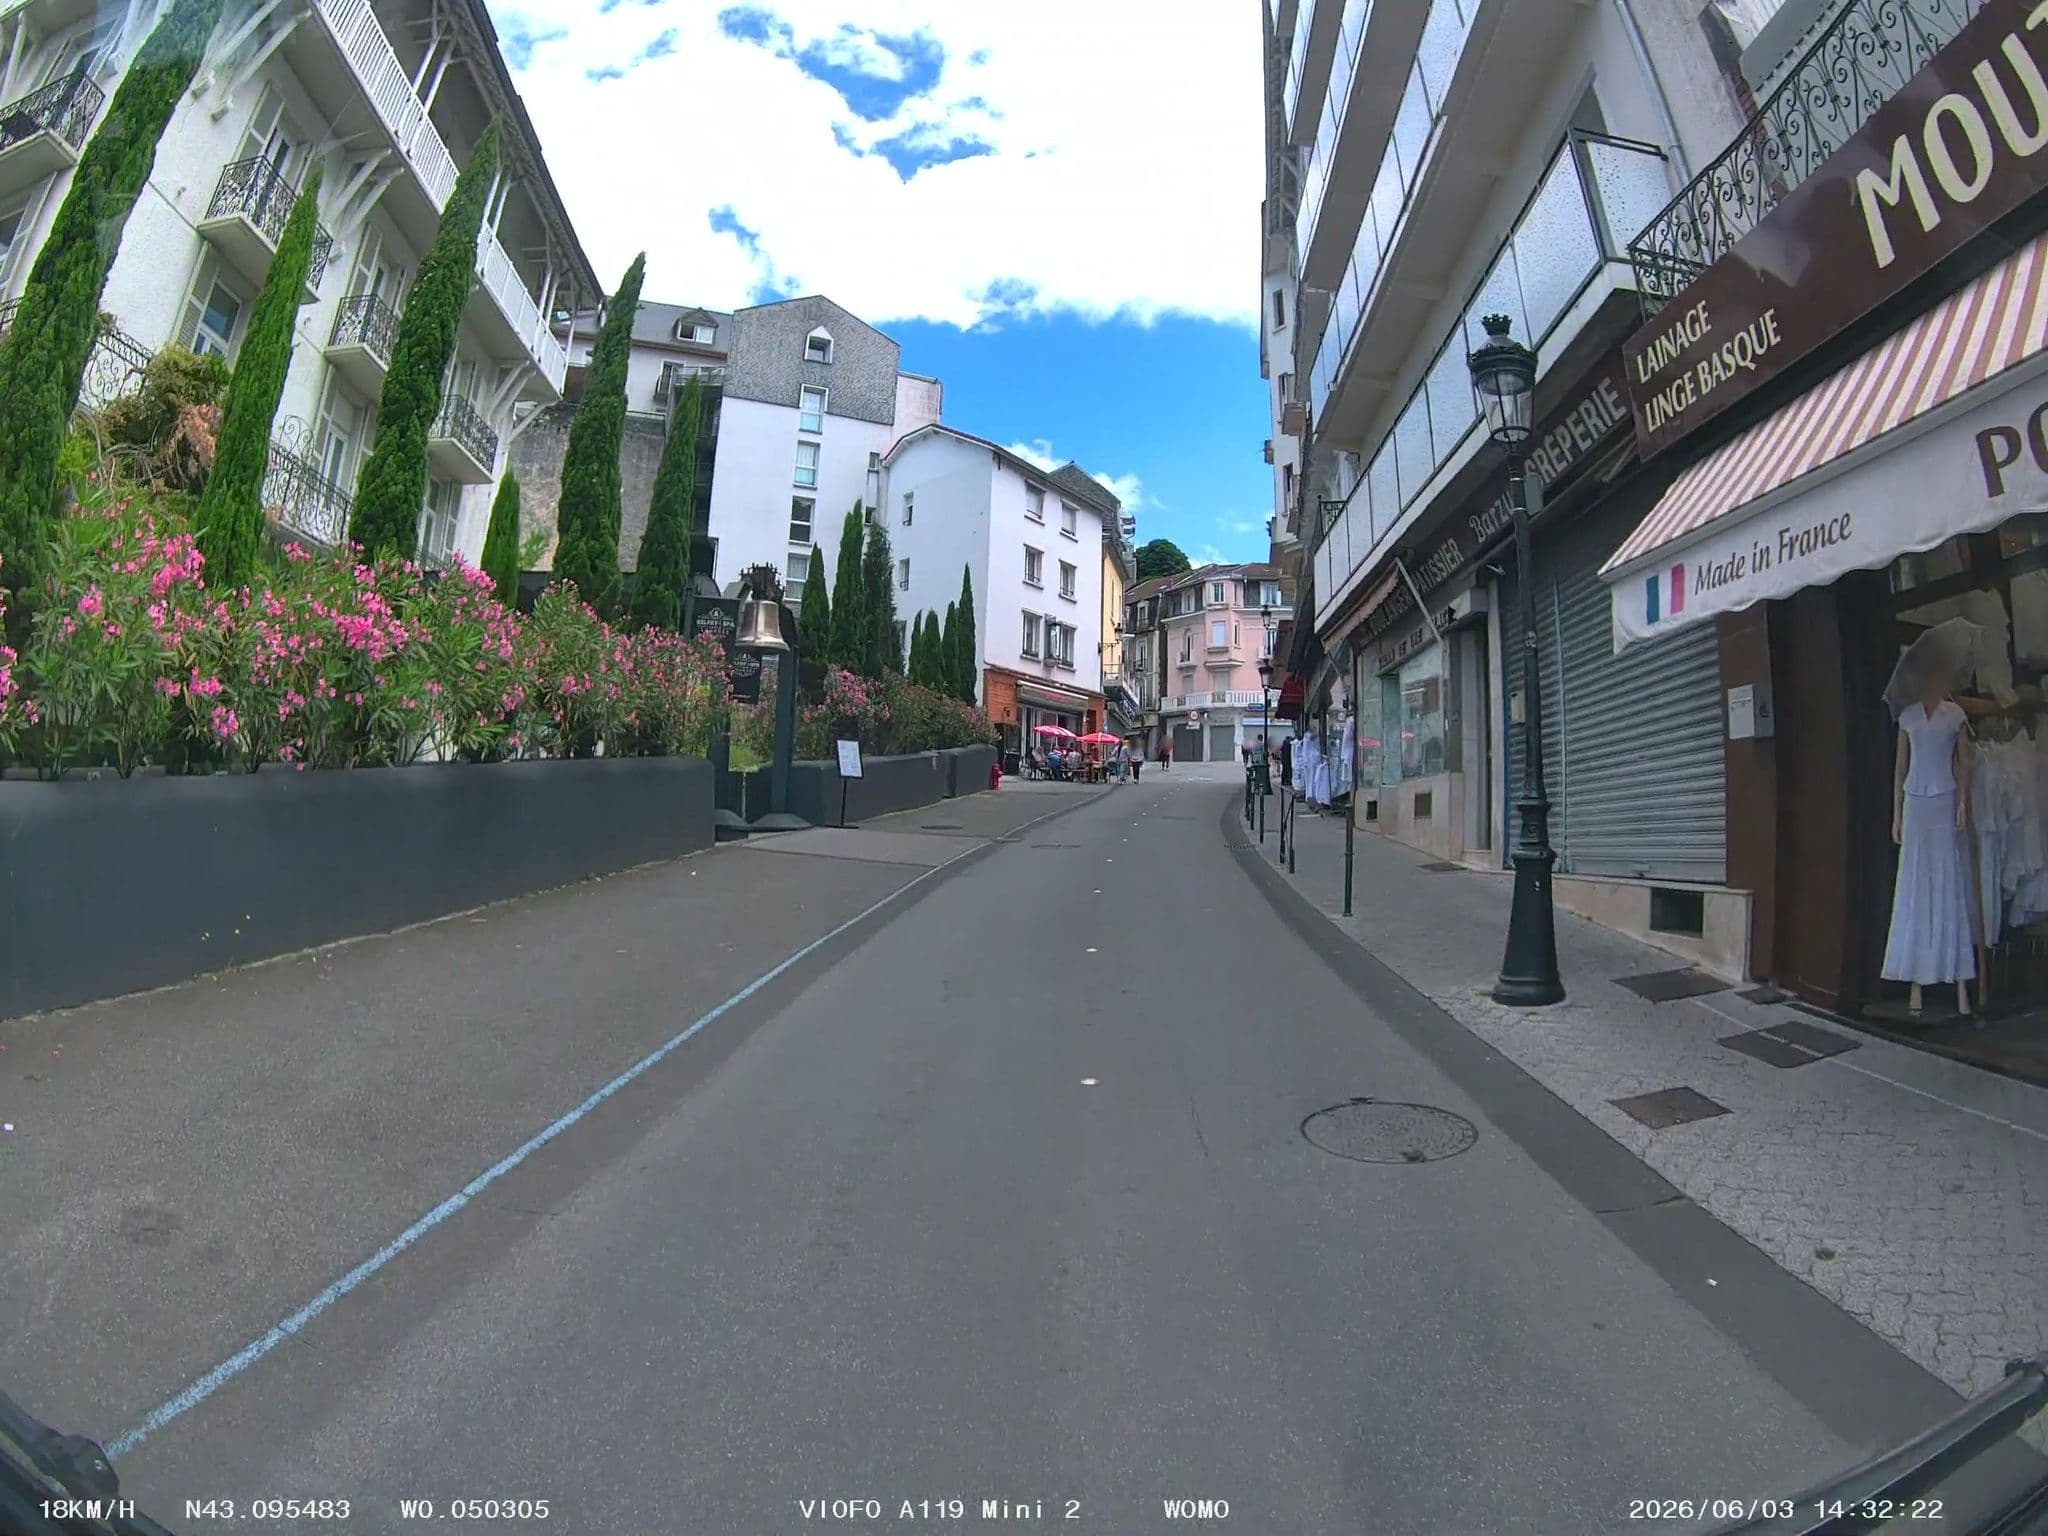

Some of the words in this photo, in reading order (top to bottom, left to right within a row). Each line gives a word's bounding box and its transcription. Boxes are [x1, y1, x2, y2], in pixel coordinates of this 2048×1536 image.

[1636, 301, 1712, 383] LAINAGE
[1644, 371, 1697, 433] LINGE
[1698, 308, 1782, 393] BASQUE
[1694, 553, 1746, 596] Made
[1751, 541, 1771, 576] in
[1777, 511, 1853, 565] France
